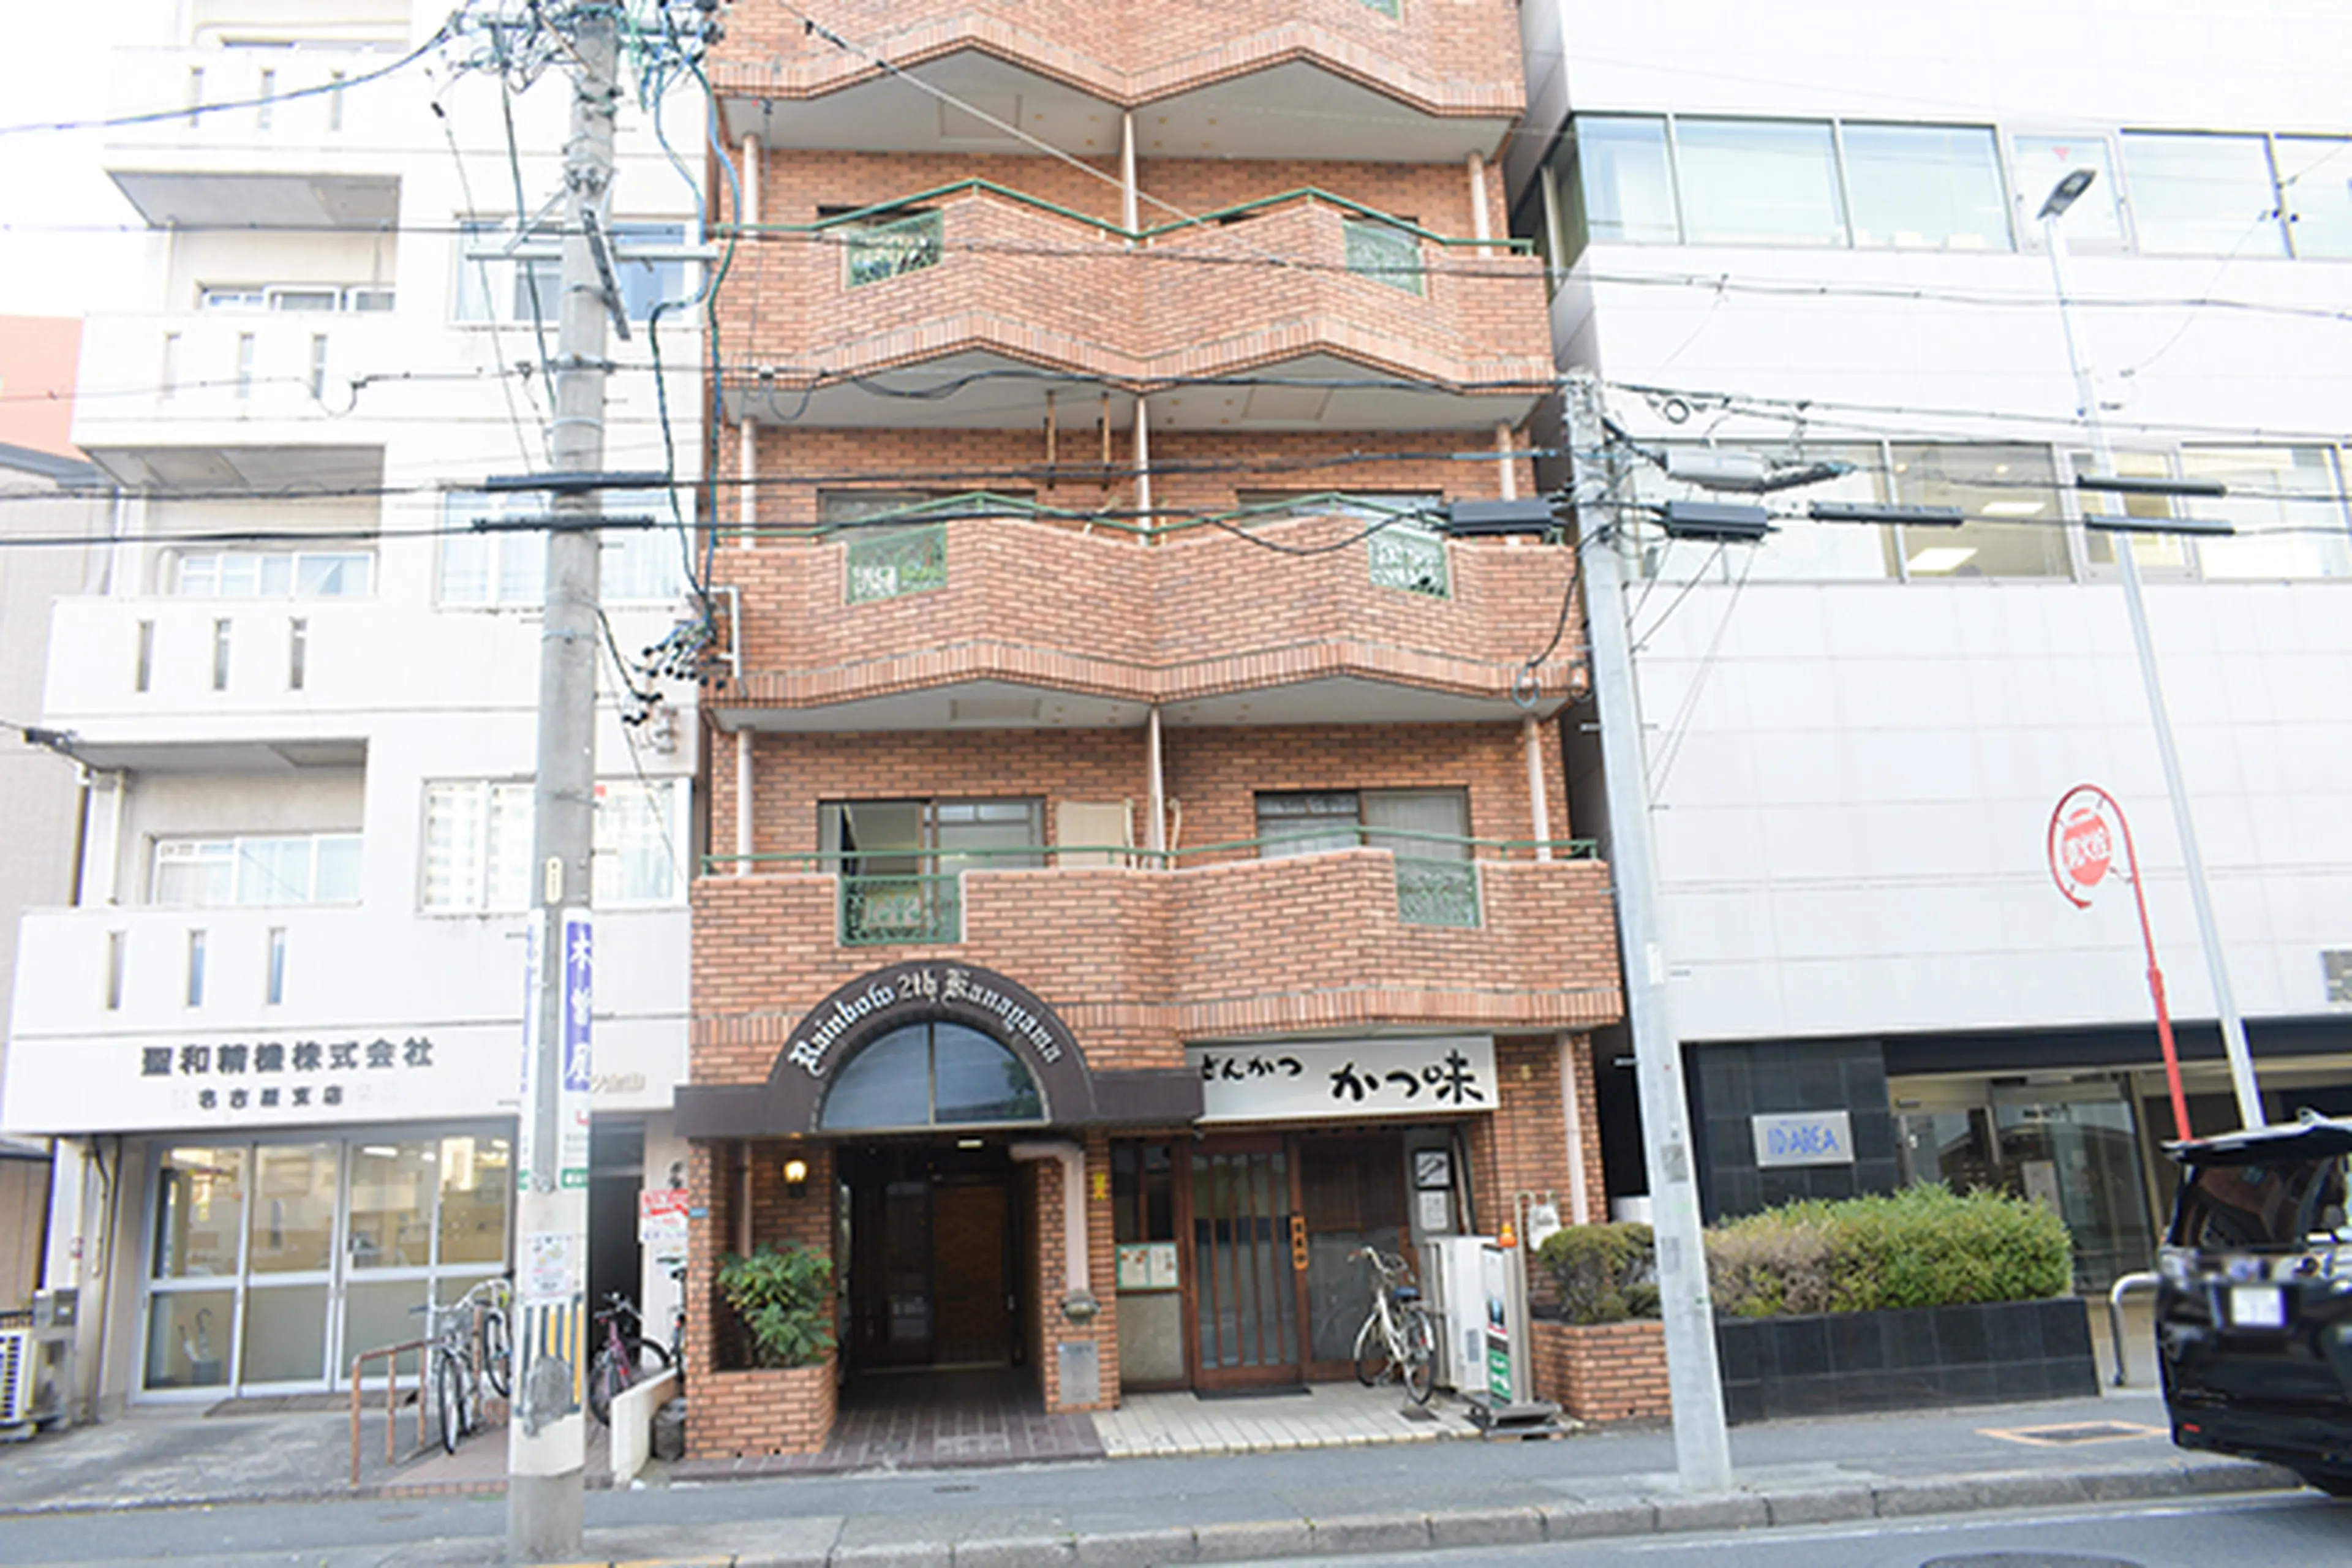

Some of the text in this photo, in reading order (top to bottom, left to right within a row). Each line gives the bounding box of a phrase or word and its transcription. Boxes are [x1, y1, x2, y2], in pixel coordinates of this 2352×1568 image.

[788, 982, 895, 1077] Rainbow
[941, 968, 1063, 1063] Kanayama
[1330, 1048, 1484, 1104] かつ味
